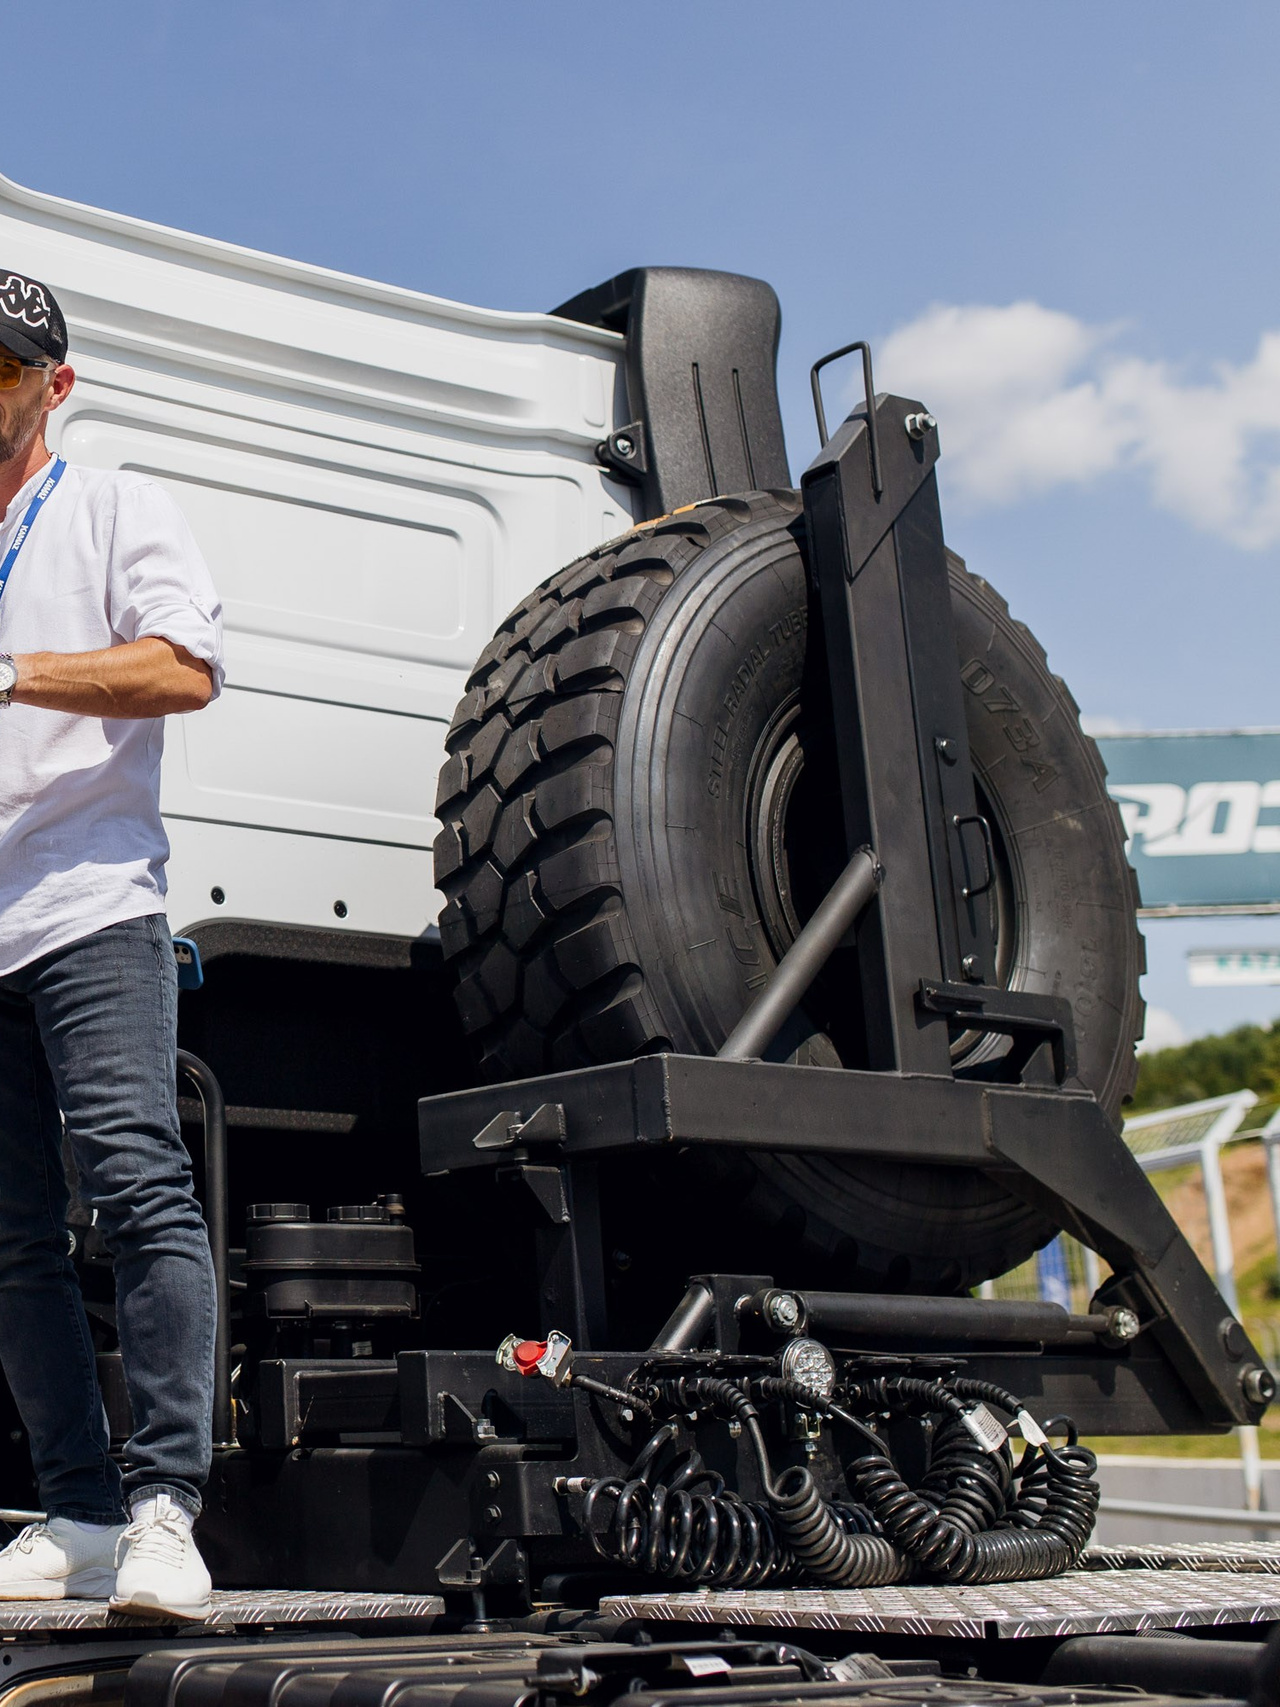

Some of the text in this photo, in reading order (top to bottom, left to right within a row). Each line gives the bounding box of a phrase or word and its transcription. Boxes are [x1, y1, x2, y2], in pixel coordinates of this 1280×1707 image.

[37, 477, 56, 501] KAMAZ
[12, 525, 29, 551] KAMAZ
[708, 722, 730, 799] STEEL
[723, 641, 771, 718] RADIAL
[960, 657, 1063, 795] 073A
